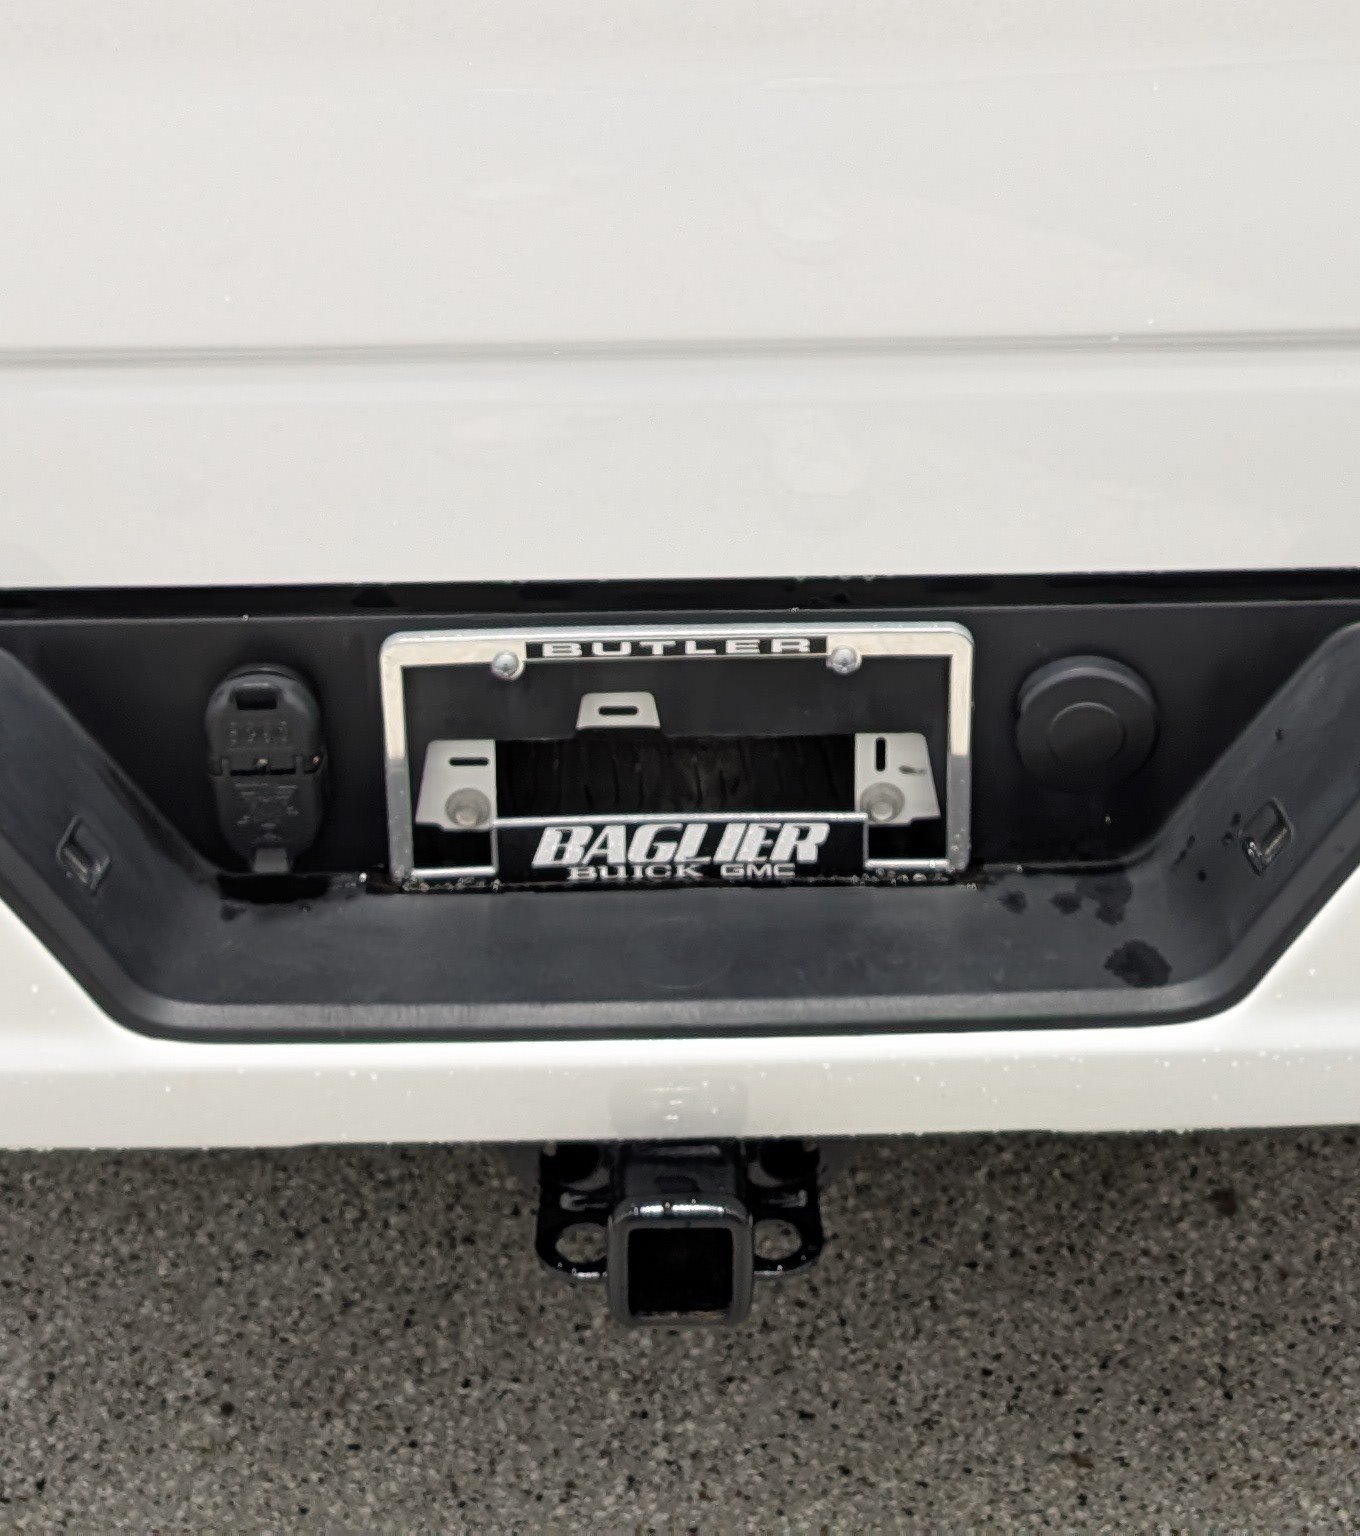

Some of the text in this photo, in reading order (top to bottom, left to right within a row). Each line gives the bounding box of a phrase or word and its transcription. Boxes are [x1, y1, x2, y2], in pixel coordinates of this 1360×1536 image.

[541, 638, 812, 658] BUTLER
[530, 822, 832, 870] BAGLIER
[566, 863, 797, 882] BUICK GMC
